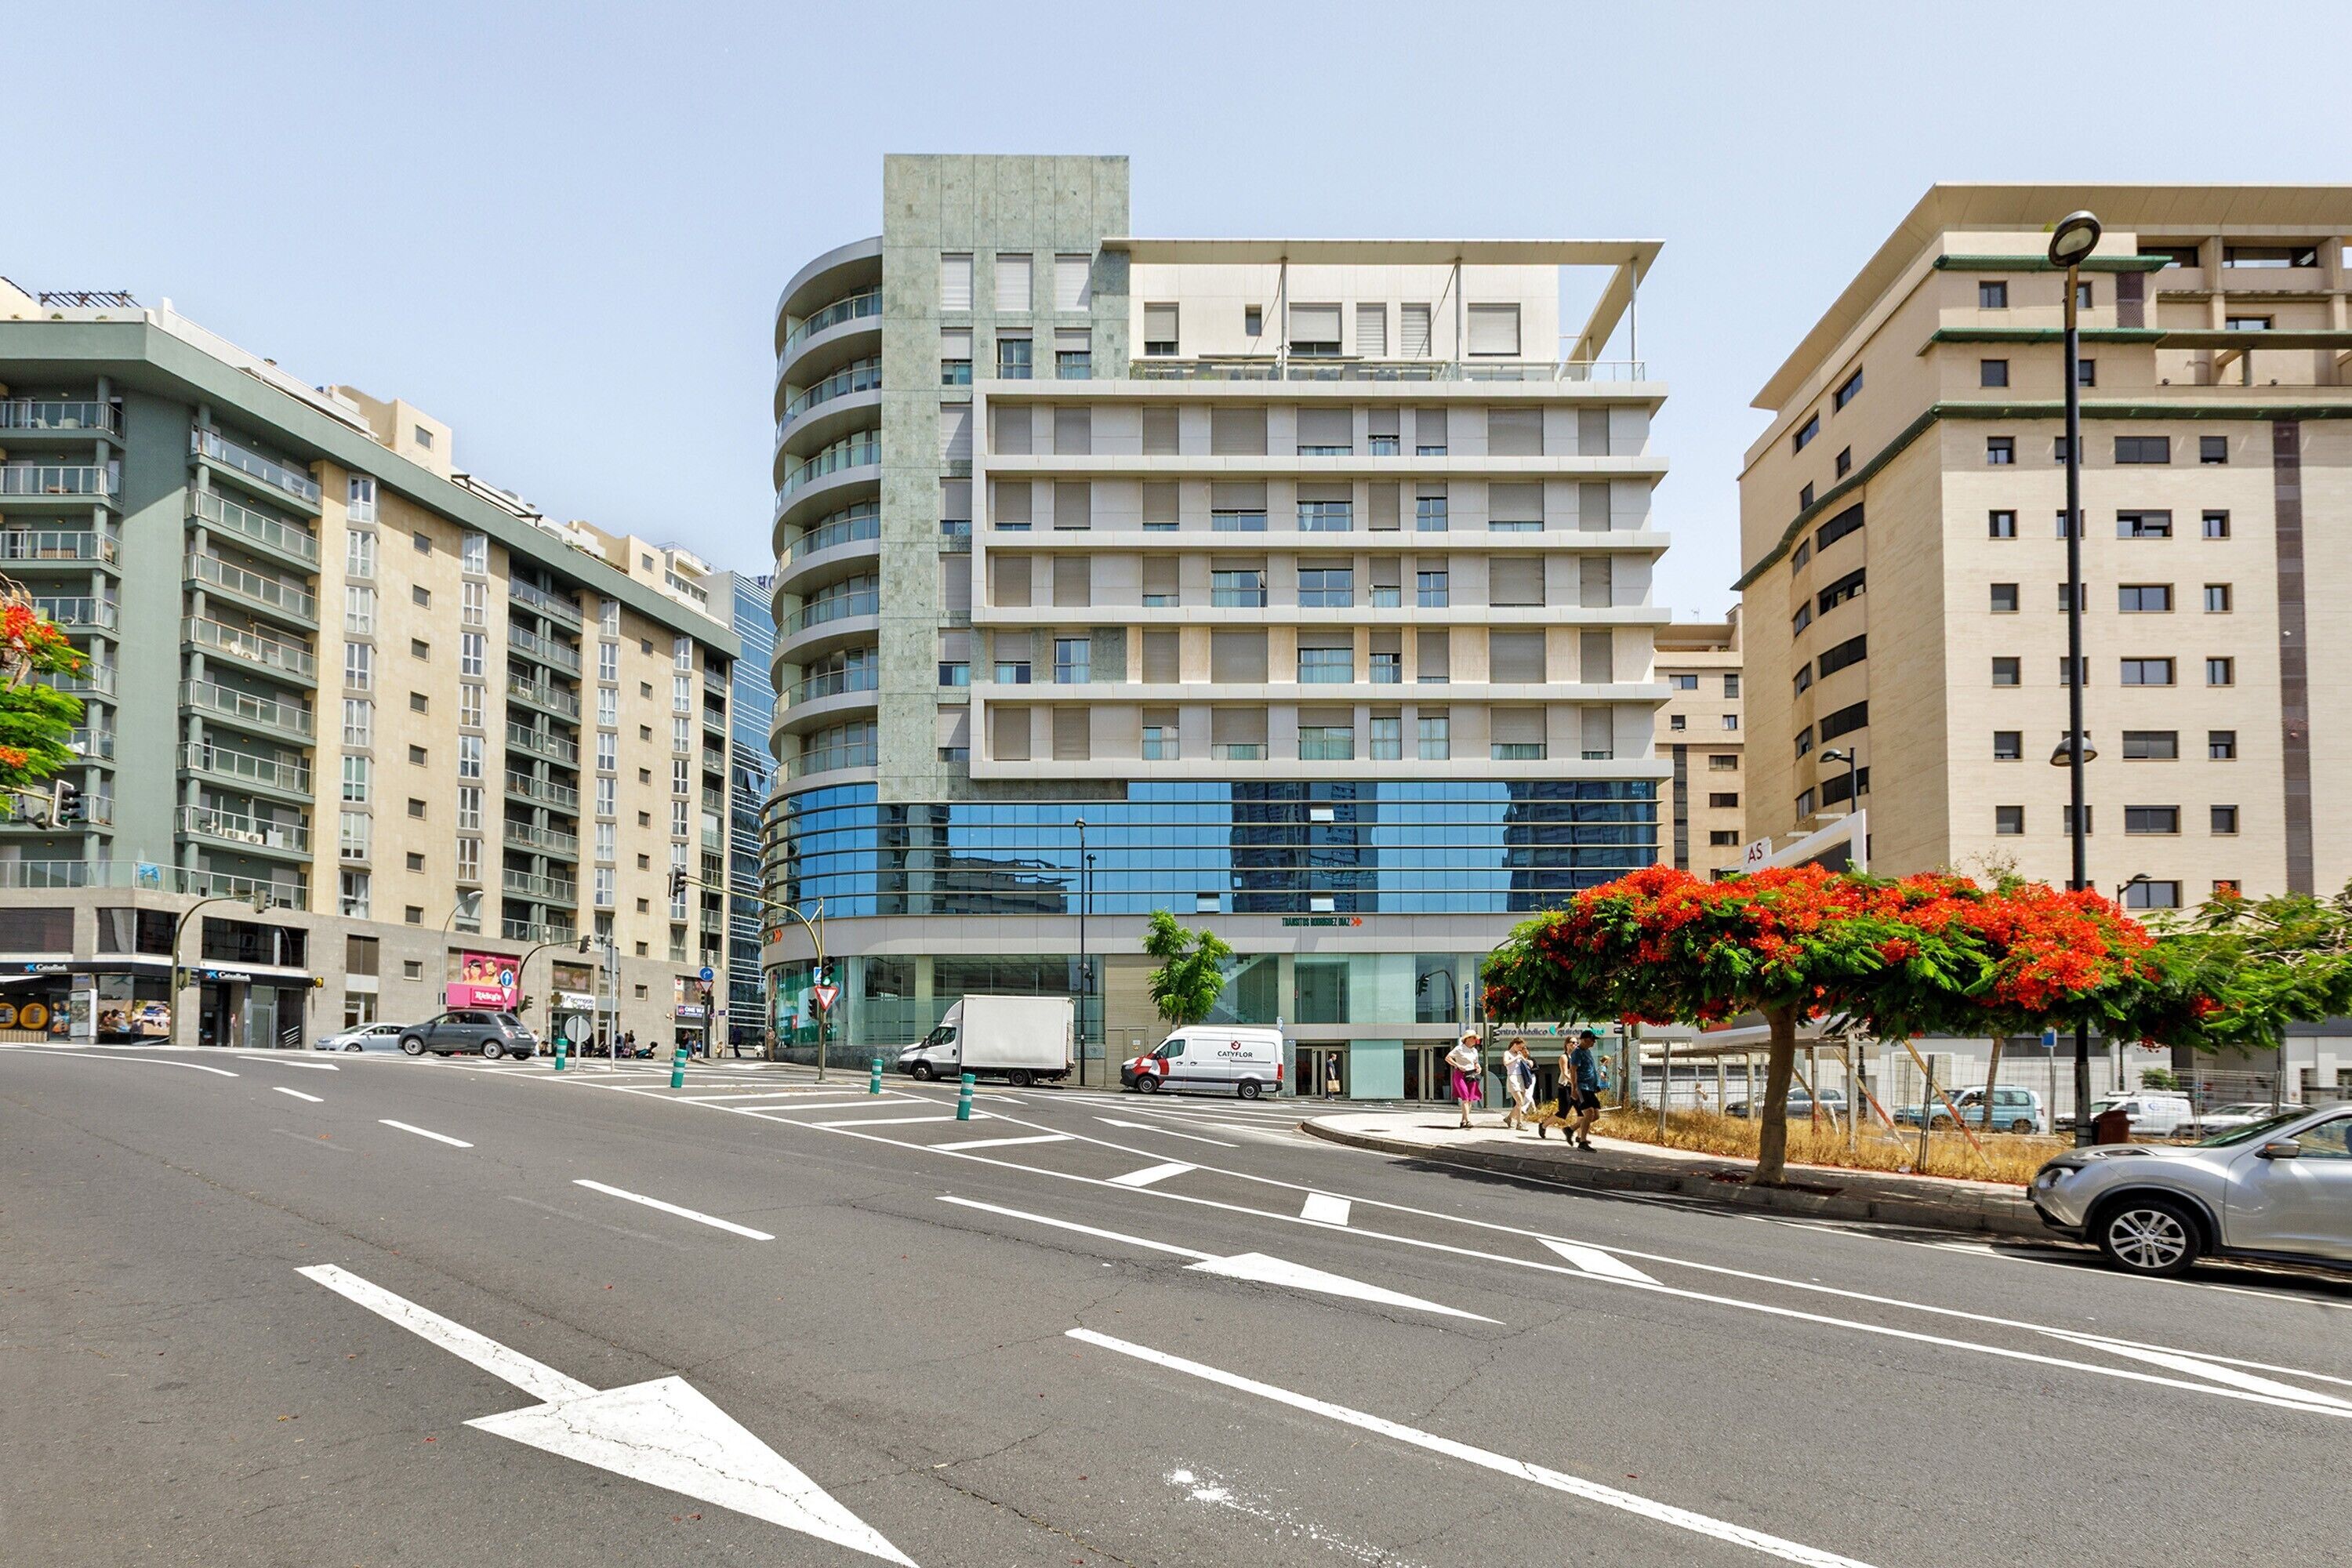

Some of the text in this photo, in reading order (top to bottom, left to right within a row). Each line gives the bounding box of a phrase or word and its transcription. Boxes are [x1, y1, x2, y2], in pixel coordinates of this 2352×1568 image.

[1748, 842, 1763, 864] AS
[1282, 916, 1350, 927] TRÁNSITOS RODRÍGUEZ DÍAZ
[1217, 1050, 1253, 1058] CATYFLOR
